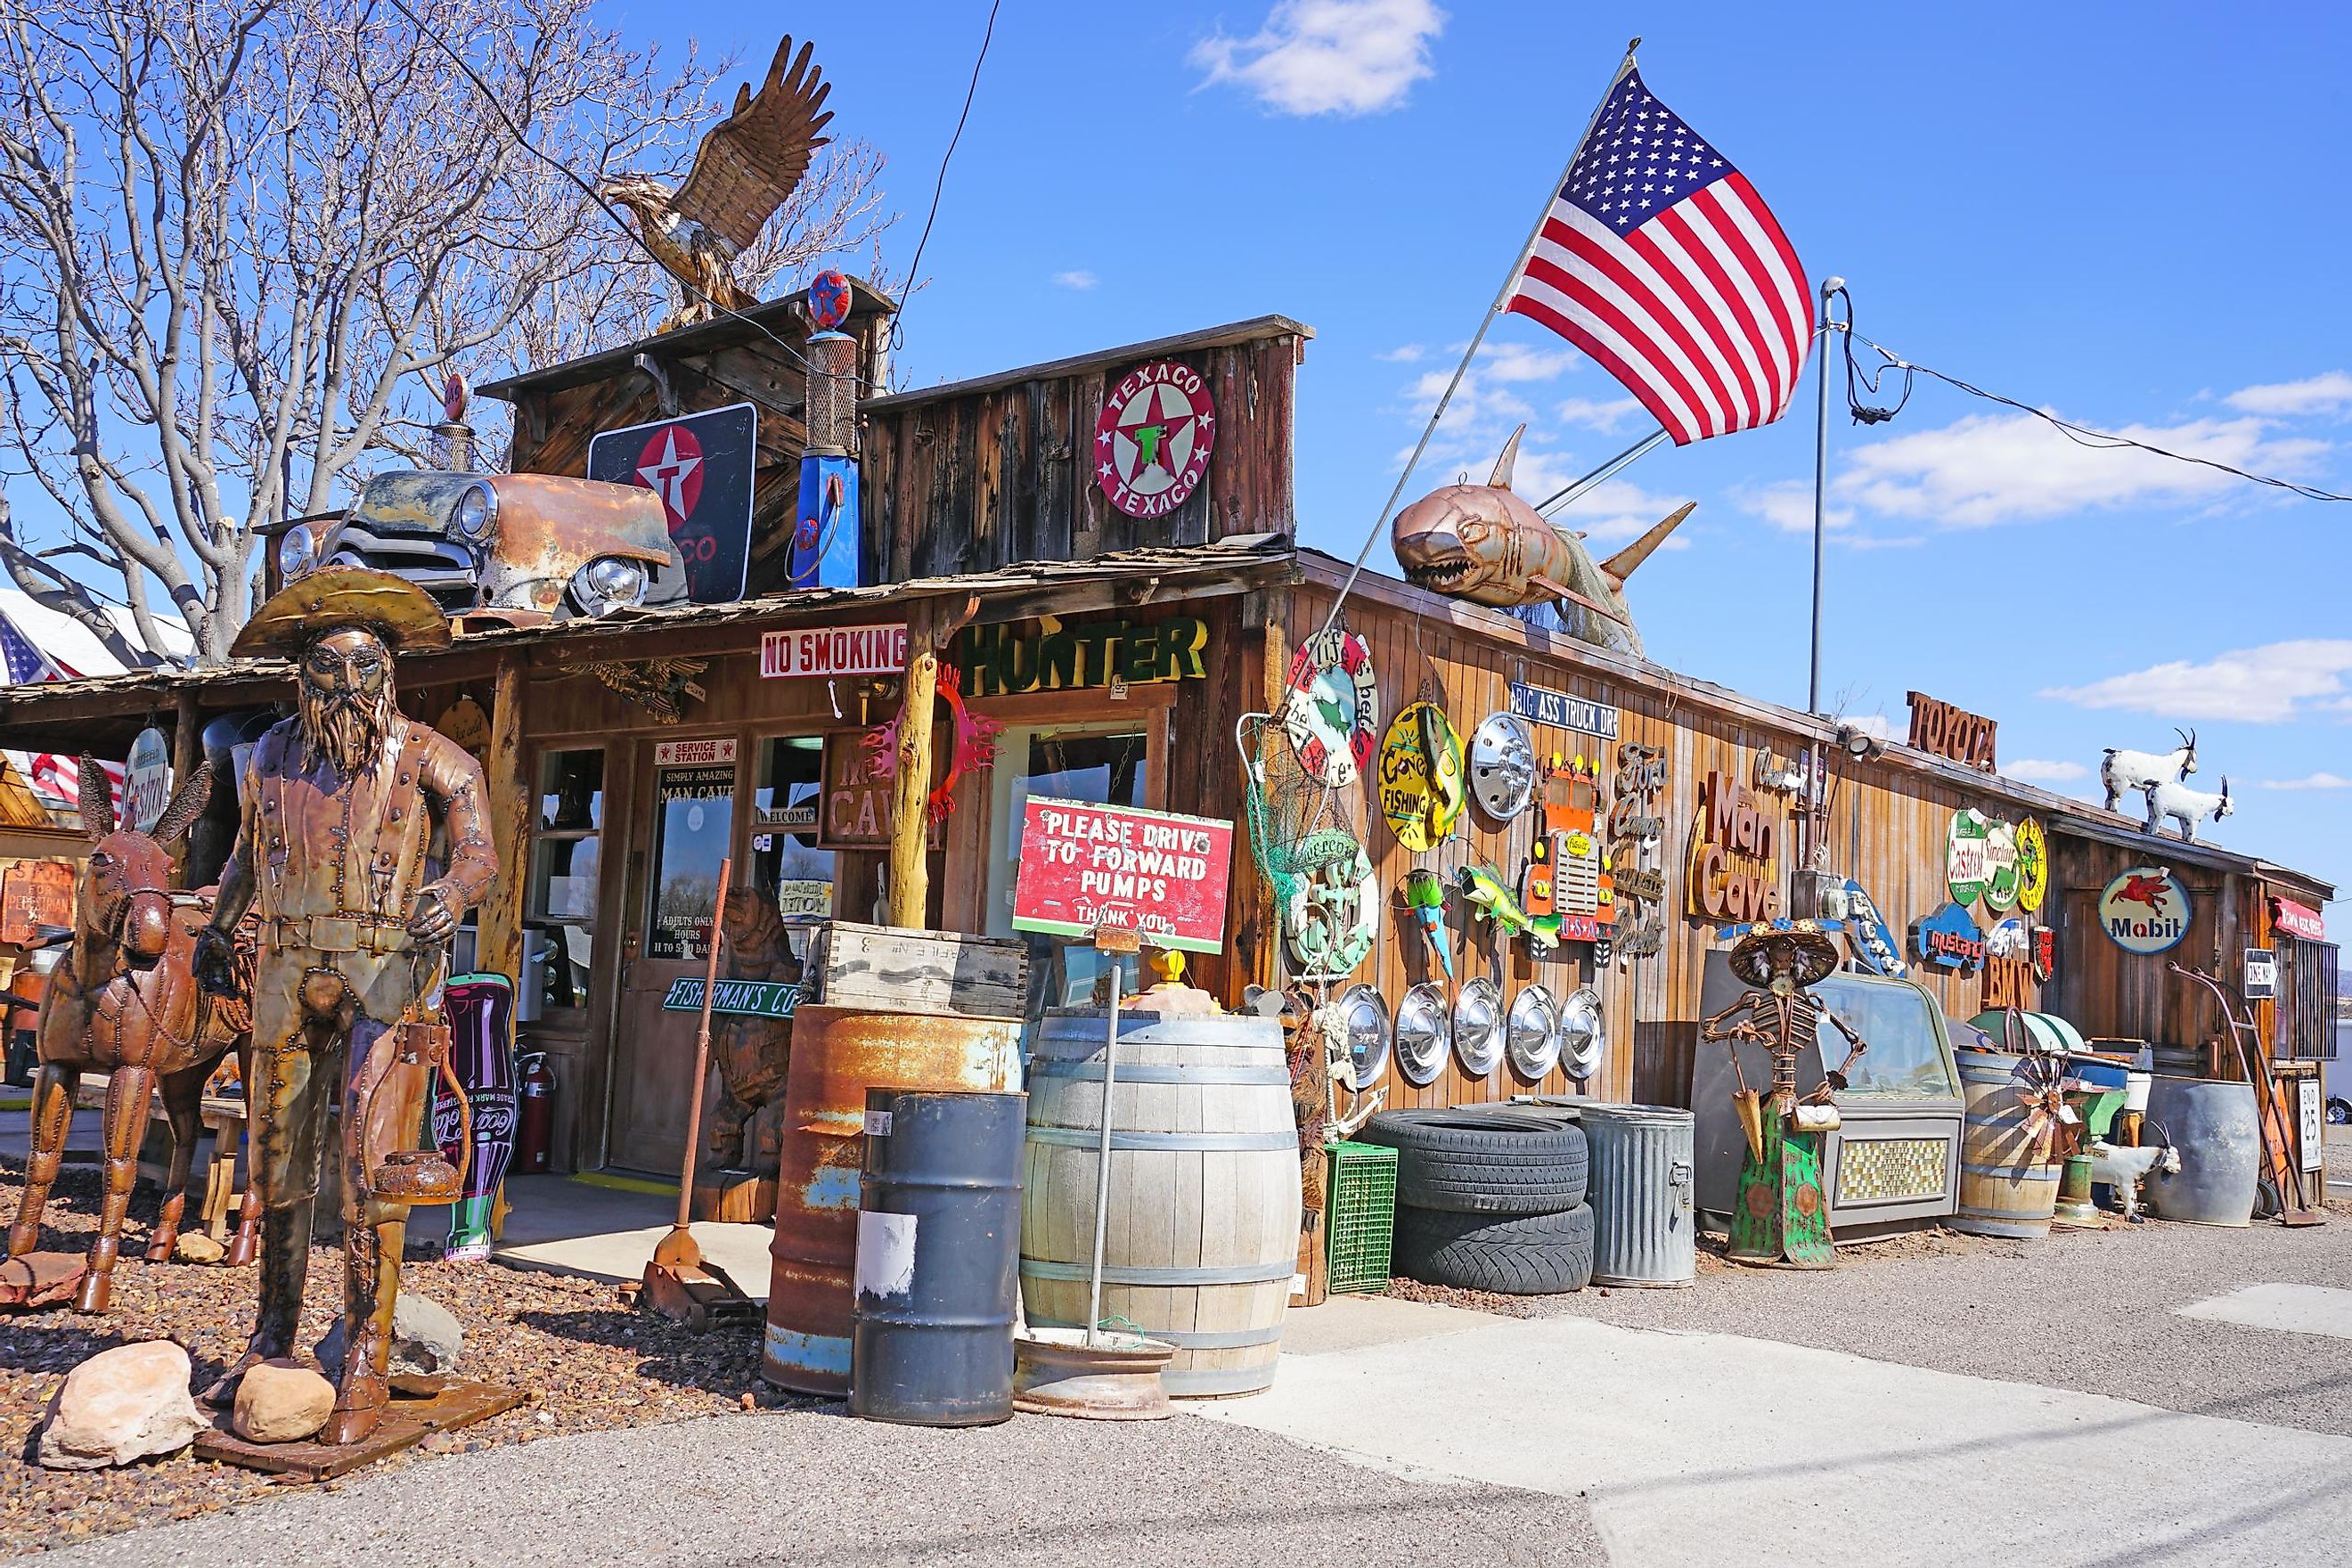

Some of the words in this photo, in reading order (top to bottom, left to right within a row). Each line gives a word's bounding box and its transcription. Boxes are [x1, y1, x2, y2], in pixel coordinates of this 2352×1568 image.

[1109, 364, 1201, 411] TEXACO
[1113, 470, 1198, 514] TEXACO
[764, 636, 791, 674] NO
[800, 628, 907, 671] SMOKING
[960, 619, 1208, 698] HUNTER
[1515, 688, 1533, 715] BIG
[1539, 693, 1560, 723] ASS
[1564, 699, 1597, 731] TRUCK
[1600, 708, 1613, 736] DR
[675, 742, 716, 753] SERVICE
[1907, 691, 1997, 775] TOYOTA
[674, 752, 715, 763] STATION
[666, 772, 693, 782] SIMPLY
[695, 770, 734, 781] AMAZING
[660, 788, 692, 804] MAN
[1384, 788, 1426, 815] FISHING
[759, 808, 812, 822] WELCOME
[1707, 771, 1773, 859] Man
[1046, 812, 1134, 844] PLEASE
[1142, 825, 1211, 854] DRIVE
[1046, 839, 1076, 864] TO
[1091, 845, 1206, 880] FORWARD
[1949, 840, 1984, 880] Castrol
[1986, 838, 2015, 863] Sinclair
[1080, 870, 1167, 902] PUMPS
[1698, 843, 1781, 925] Cave
[662, 915, 692, 927] ADULTS
[1076, 905, 1129, 927] THANK
[1137, 911, 1168, 931] YOU
[2111, 918, 2181, 938] Mobil
[663, 943, 674, 953] TO
[674, 929, 700, 940] HOURS
[1931, 930, 1983, 963] mustang
[1988, 955, 2034, 1010] BMW
[2248, 965, 2261, 983] ONE
[671, 981, 767, 1010] FISHRMAN'S
[771, 987, 796, 1013] CO
[475, 1092, 495, 1103] MARK
[2304, 1108, 2316, 1140] 25
